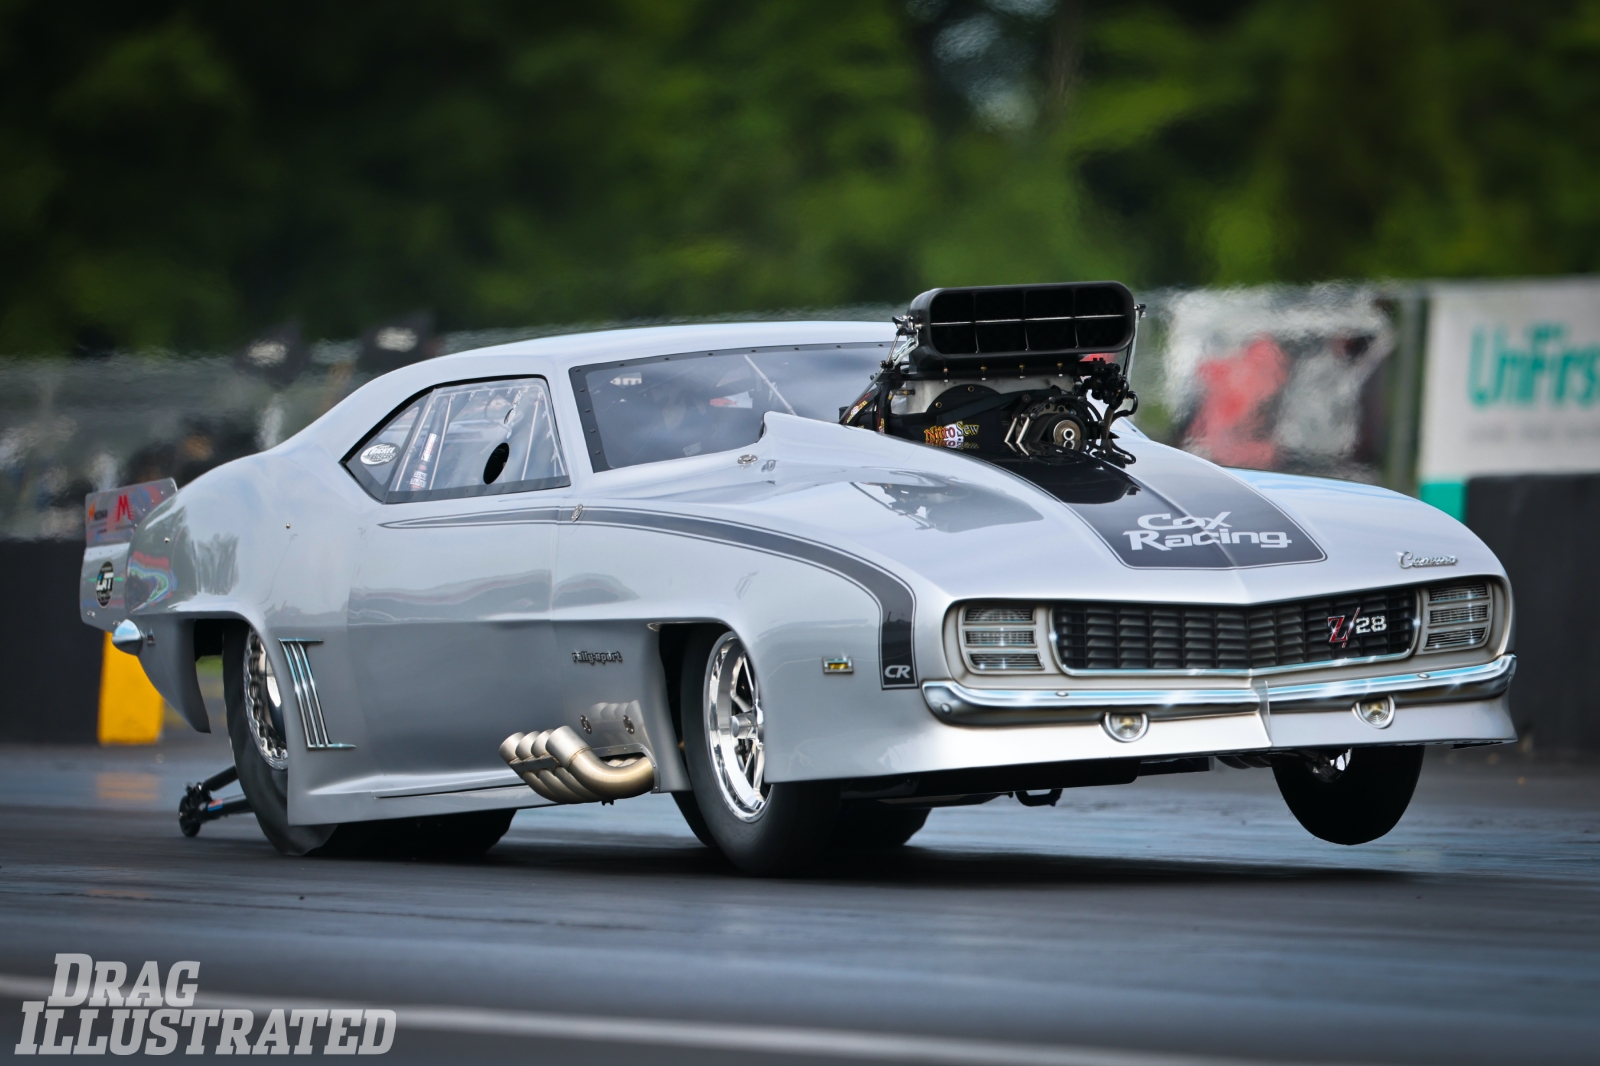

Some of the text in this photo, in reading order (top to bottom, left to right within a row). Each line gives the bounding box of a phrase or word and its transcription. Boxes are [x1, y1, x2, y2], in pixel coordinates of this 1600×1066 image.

[924, 420, 979, 441] Nitro Sew
[1137, 511, 1232, 531] Cox
[1122, 528, 1292, 551] Racing
[1398, 550, 1459, 570] Camaro
[884, 664, 911, 679] CR
